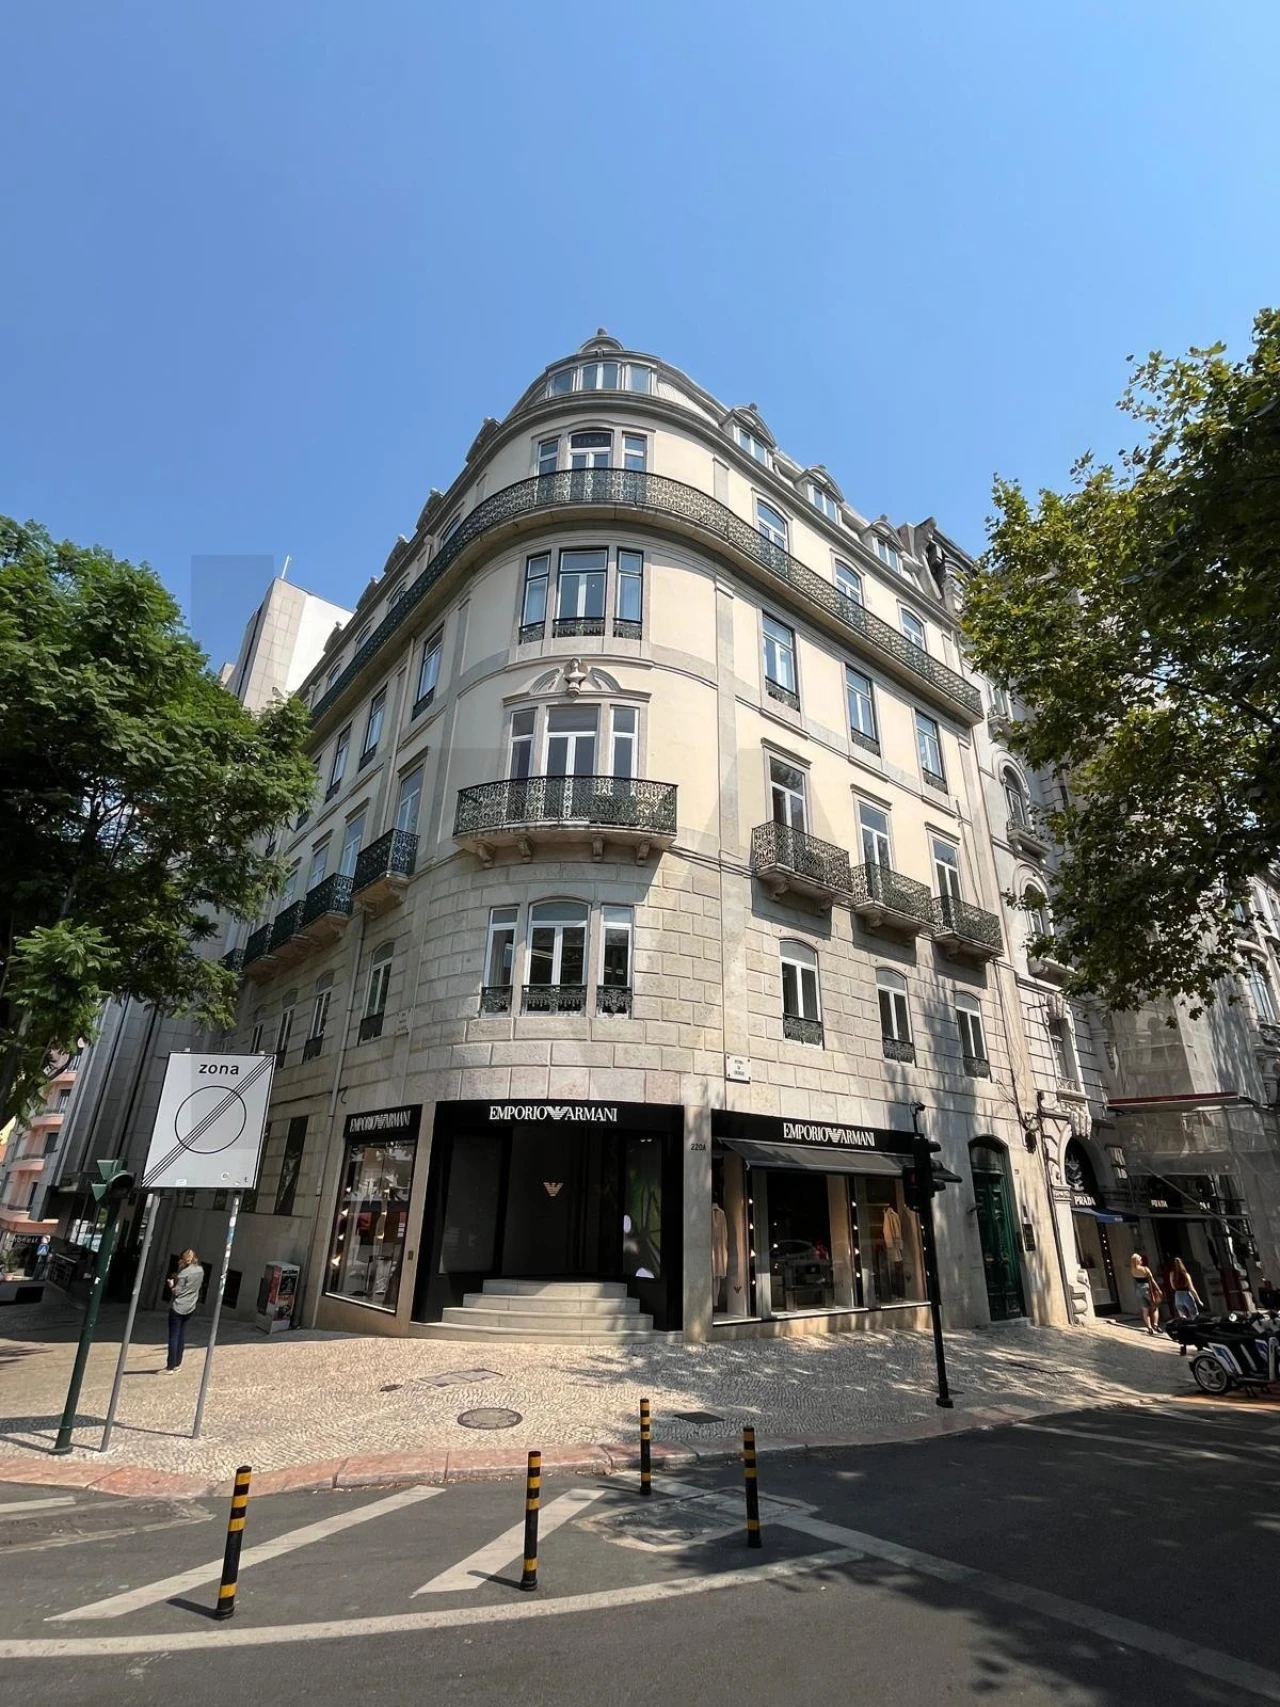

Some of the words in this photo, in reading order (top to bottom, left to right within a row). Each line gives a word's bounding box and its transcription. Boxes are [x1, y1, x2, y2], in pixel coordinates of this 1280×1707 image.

[198, 1063, 240, 1075] zona
[489, 1105, 548, 1120] EMPORIO
[564, 1106, 618, 1122] ARMANI
[783, 1122, 828, 1142] EMPORIO
[840, 1129, 875, 1146] ARMANI
[1074, 1195, 1096, 1206] PRADA
